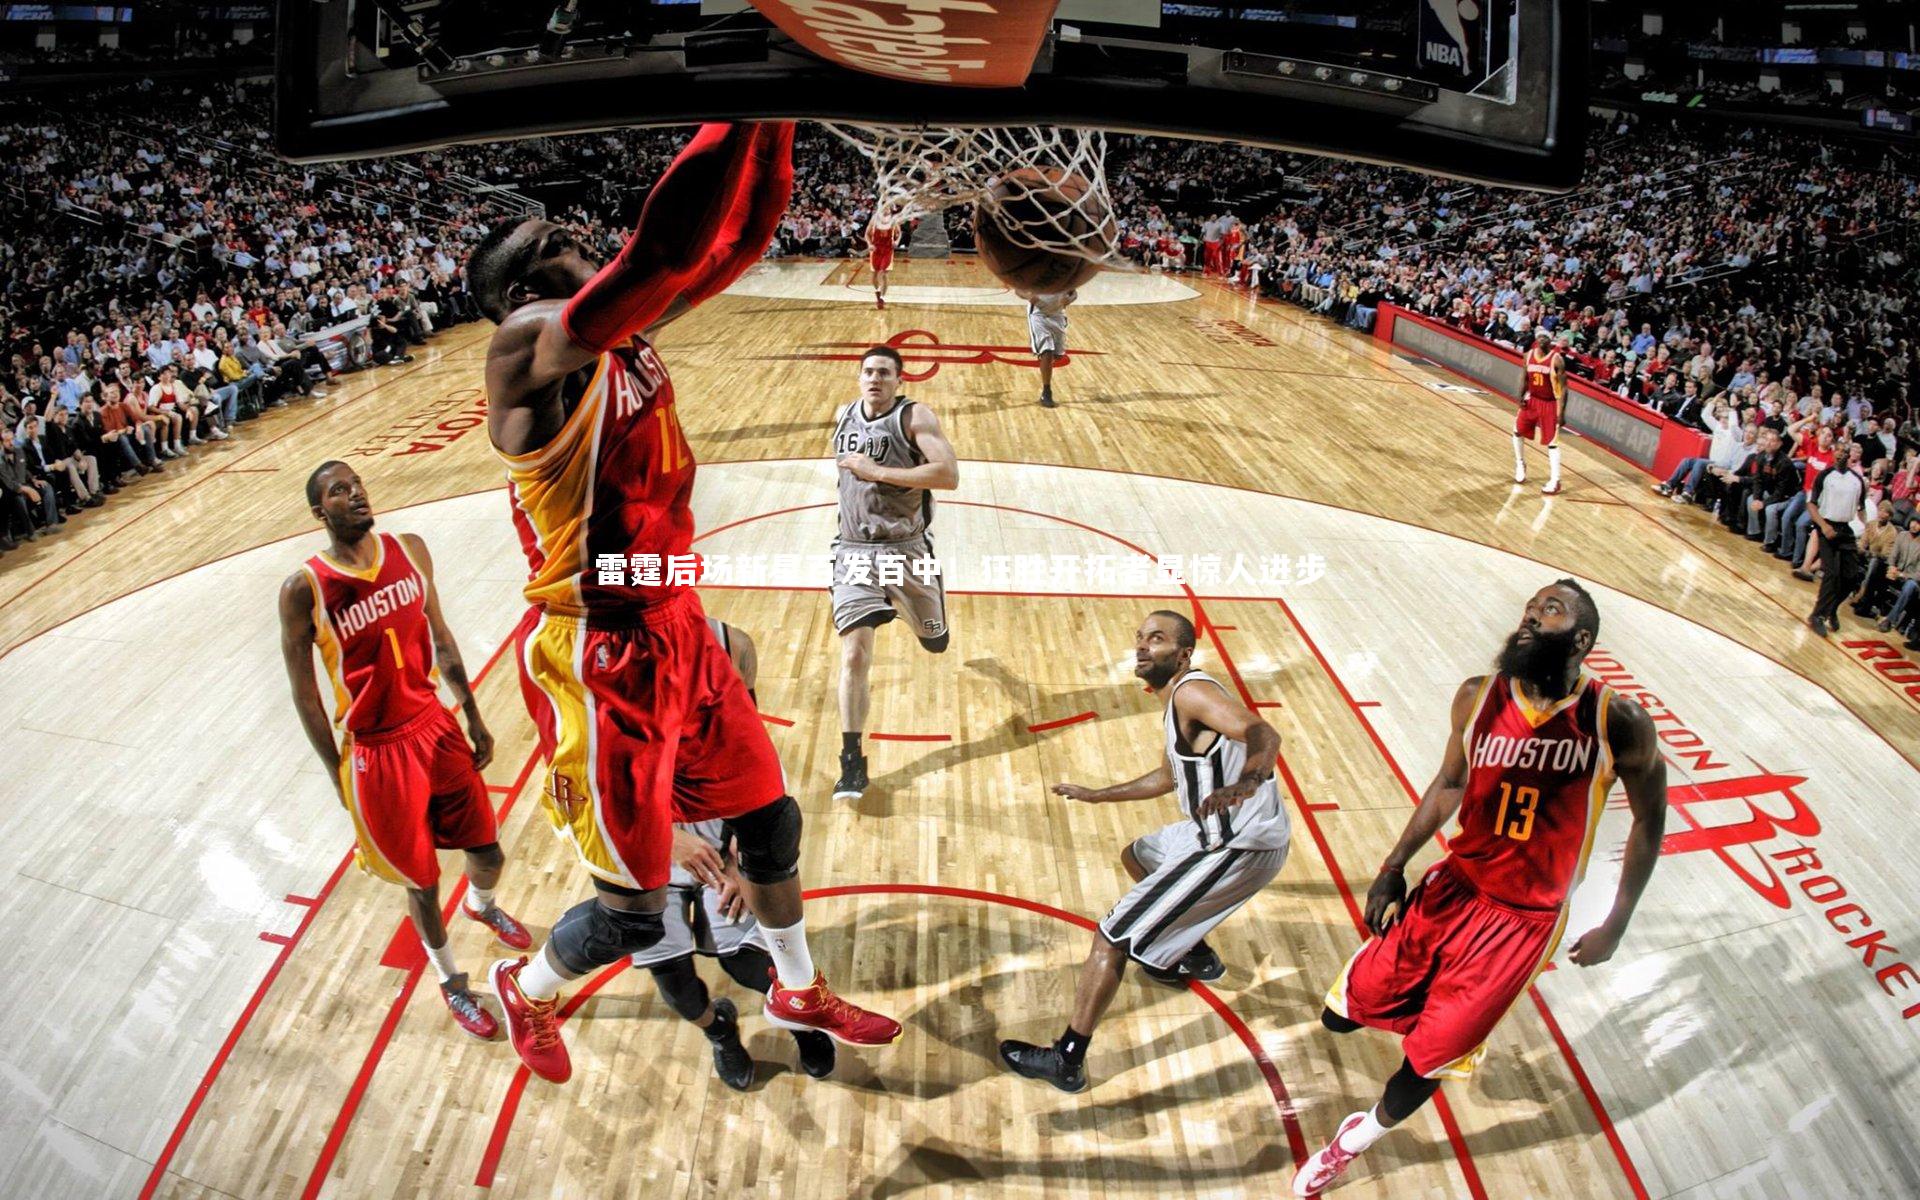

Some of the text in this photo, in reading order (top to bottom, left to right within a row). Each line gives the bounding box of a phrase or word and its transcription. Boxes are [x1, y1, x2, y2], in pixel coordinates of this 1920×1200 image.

[1425, 41, 1460, 67] NBA
[1532, 372, 1544, 387] 31
[838, 432, 859, 454] 16
[333, 571, 421, 641] HOUSTON
[385, 627, 405, 669] 1
[1472, 732, 1592, 774] HOUSTON
[1494, 781, 1540, 841] 13
